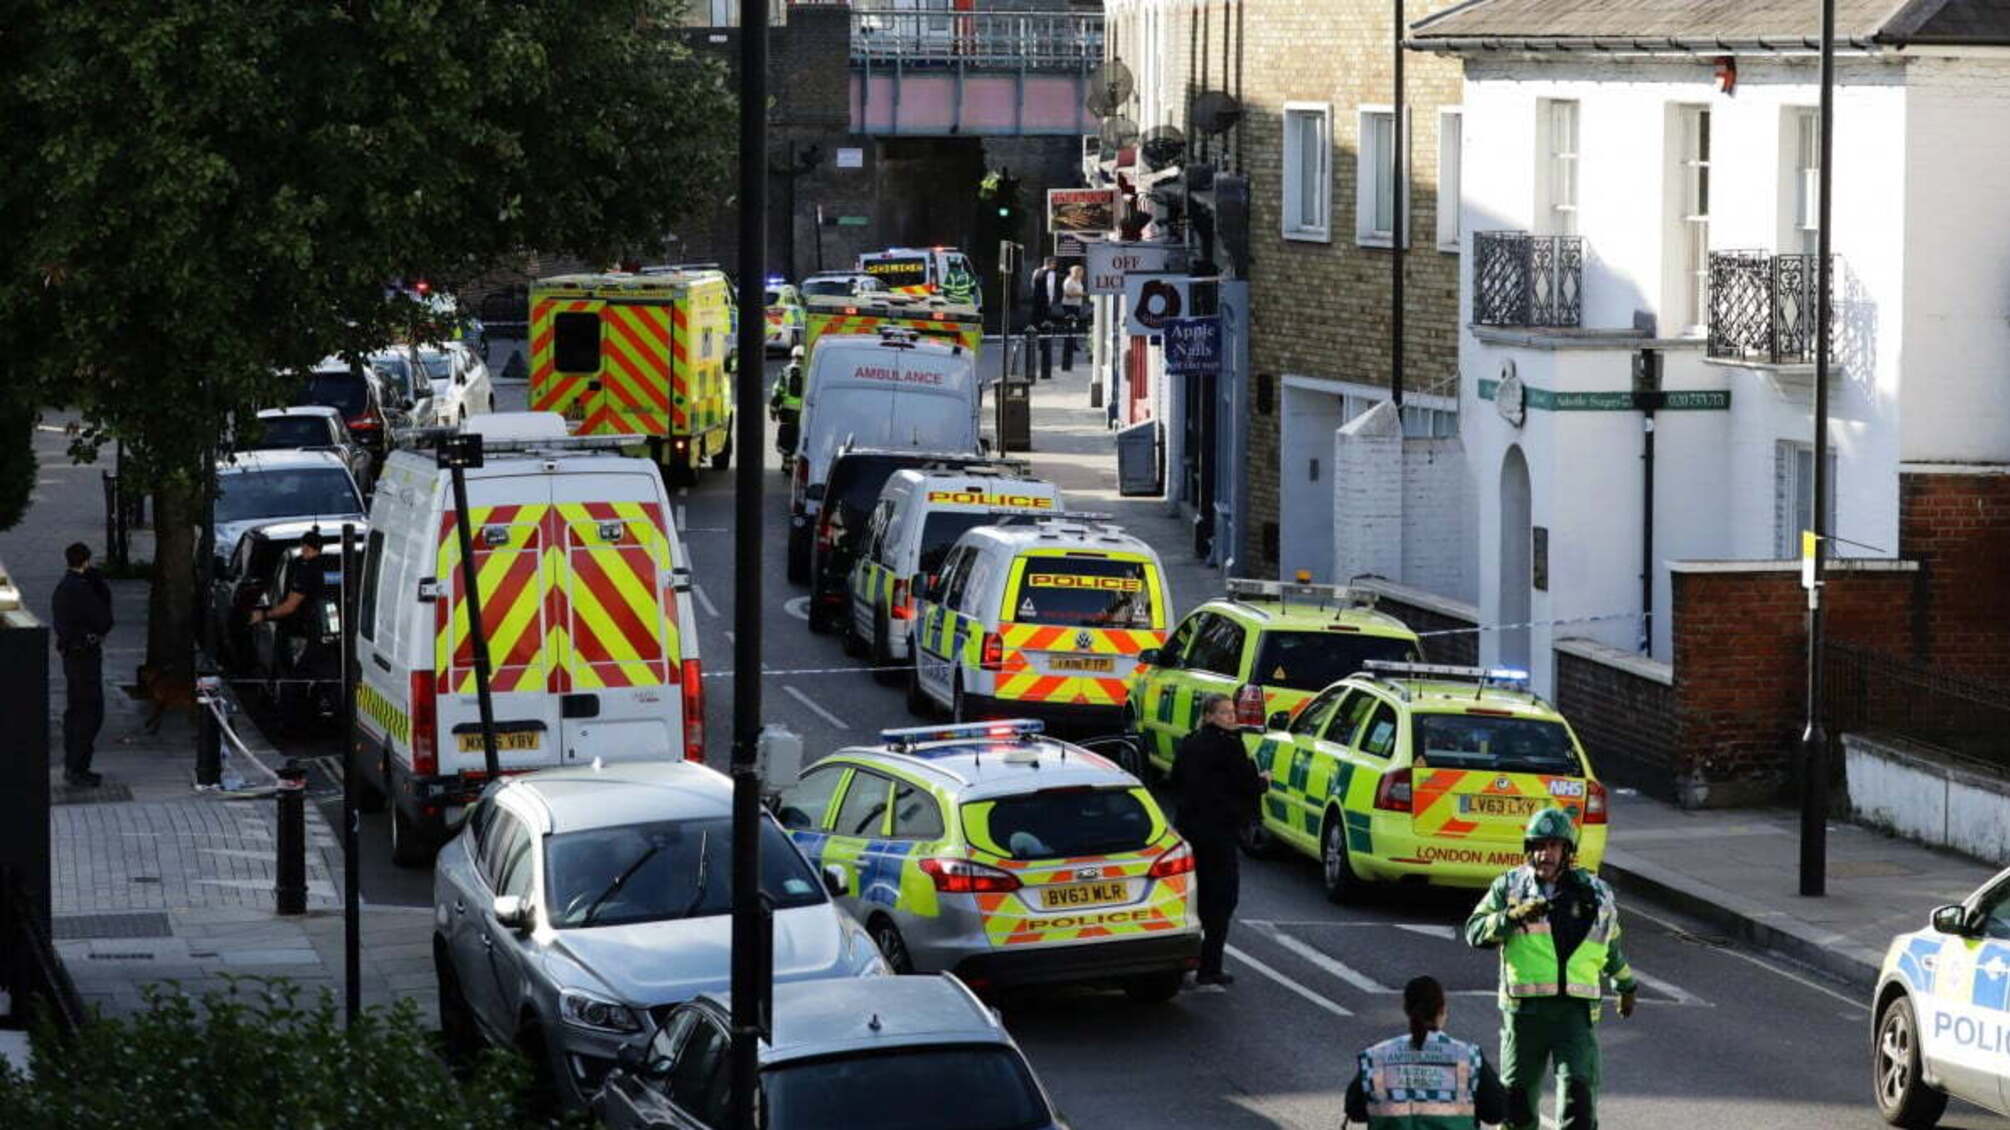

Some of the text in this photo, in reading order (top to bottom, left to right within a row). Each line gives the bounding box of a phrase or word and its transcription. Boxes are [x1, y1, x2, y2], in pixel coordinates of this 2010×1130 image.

[1112, 255, 1142, 270] OFF
[1171, 324, 1216, 341] Apple
[855, 366, 944, 385] AMBULANCE
[928, 491, 1052, 508] POLICE
[1031, 575, 1140, 591] POLICE
[1551, 780, 1583, 797] NHS
[1469, 796, 1505, 814] LV63
[1416, 846, 1482, 864] LONDON
[1049, 883, 1122, 906] BV63 WLR
[1028, 909, 1151, 930] POLICE
